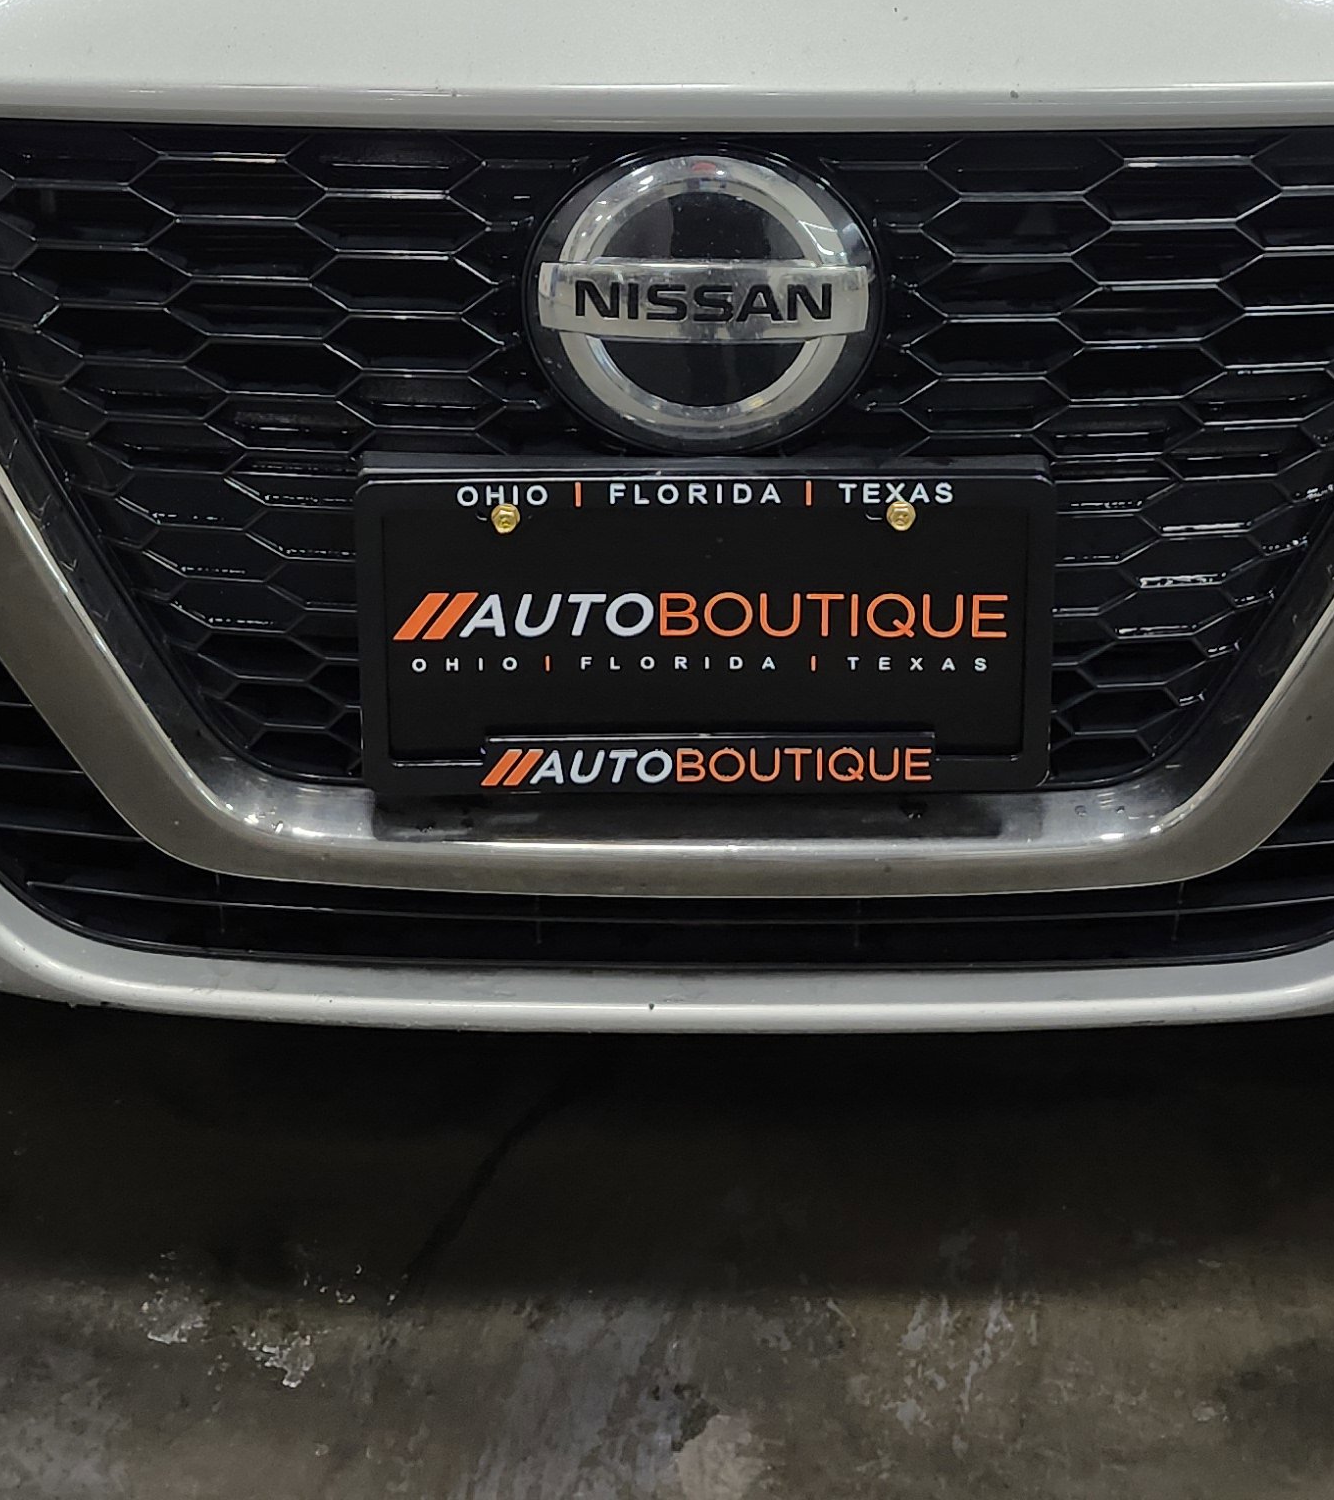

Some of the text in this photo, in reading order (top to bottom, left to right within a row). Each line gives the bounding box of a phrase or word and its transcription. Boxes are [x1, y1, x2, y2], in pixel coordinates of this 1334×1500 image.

[574, 279, 833, 323] NISSAN
[456, 482, 954, 506] OHIO FLORIDA TEXAS
[459, 592, 1009, 639] AUTOBOUTIQUE
[411, 656, 987, 672] OHIO FLORIDA TEXAS
[530, 746, 933, 785] AUTOBOUTIQUE
